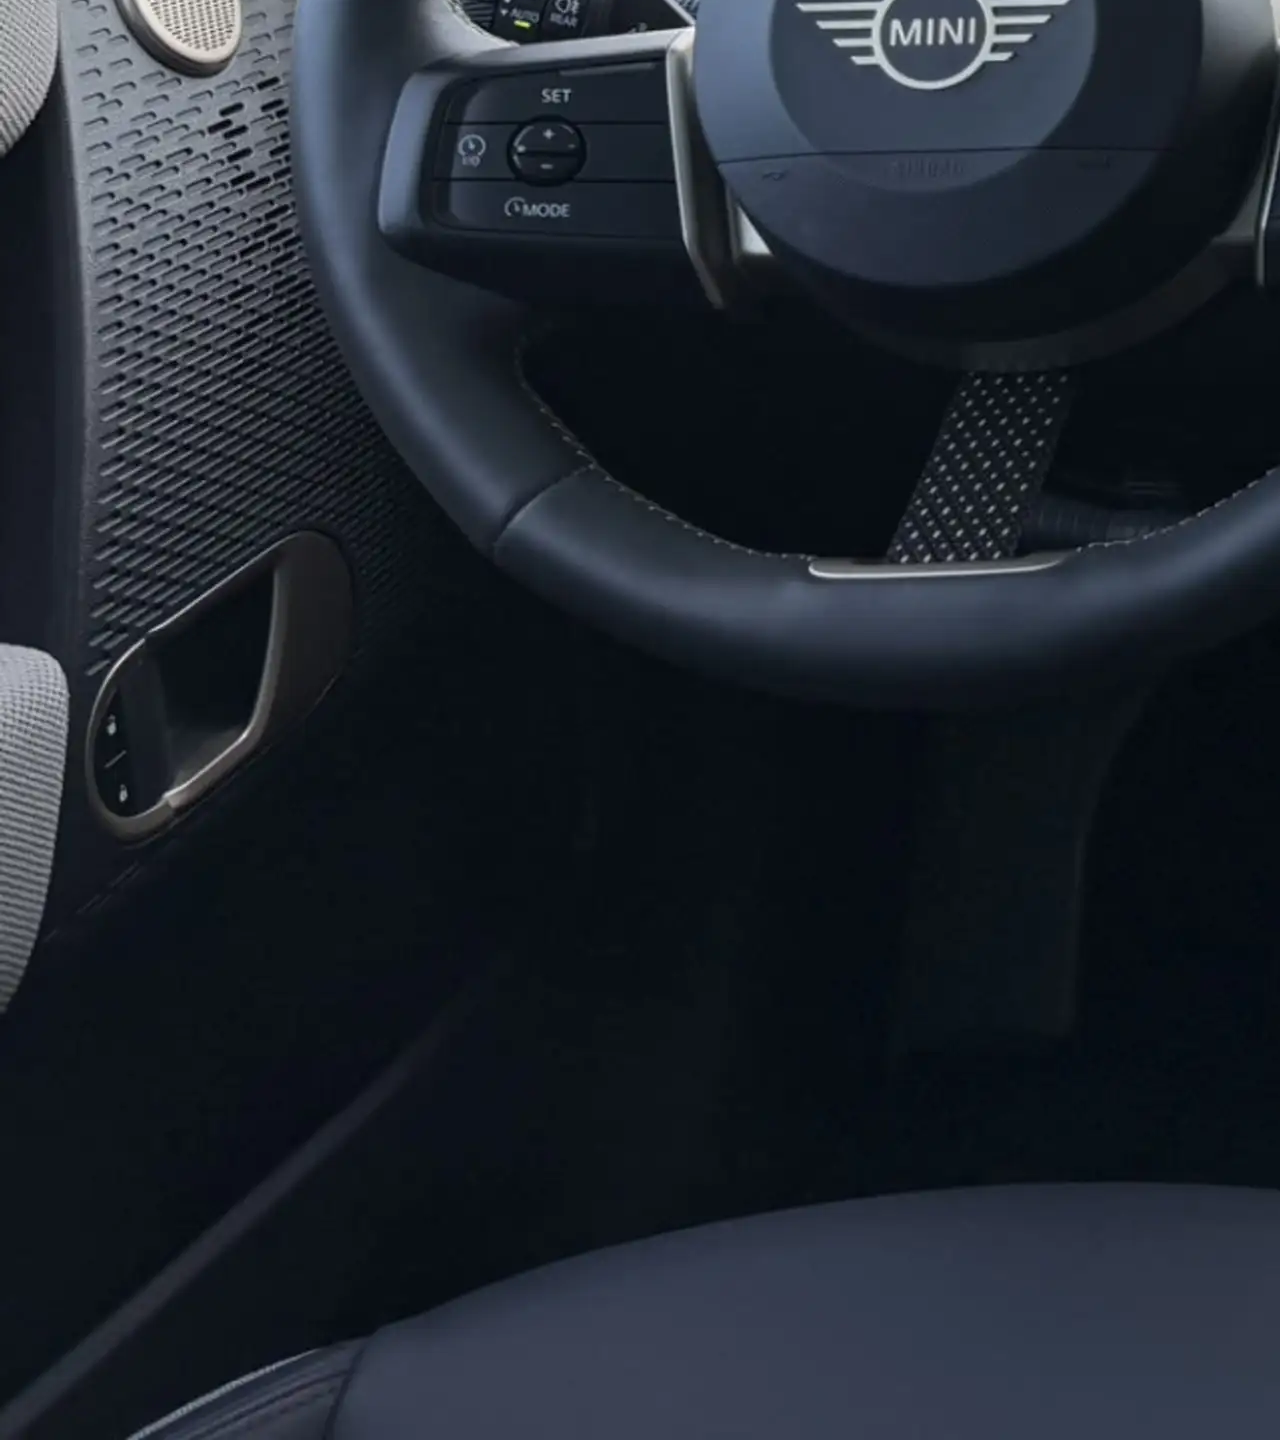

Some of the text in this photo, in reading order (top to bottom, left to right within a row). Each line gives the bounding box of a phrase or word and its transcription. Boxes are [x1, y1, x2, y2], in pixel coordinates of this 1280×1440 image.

[549, 12, 578, 29] REAR
[888, 16, 977, 47] MINI
[540, 88, 572, 104] SET
[522, 203, 571, 218] MODE
